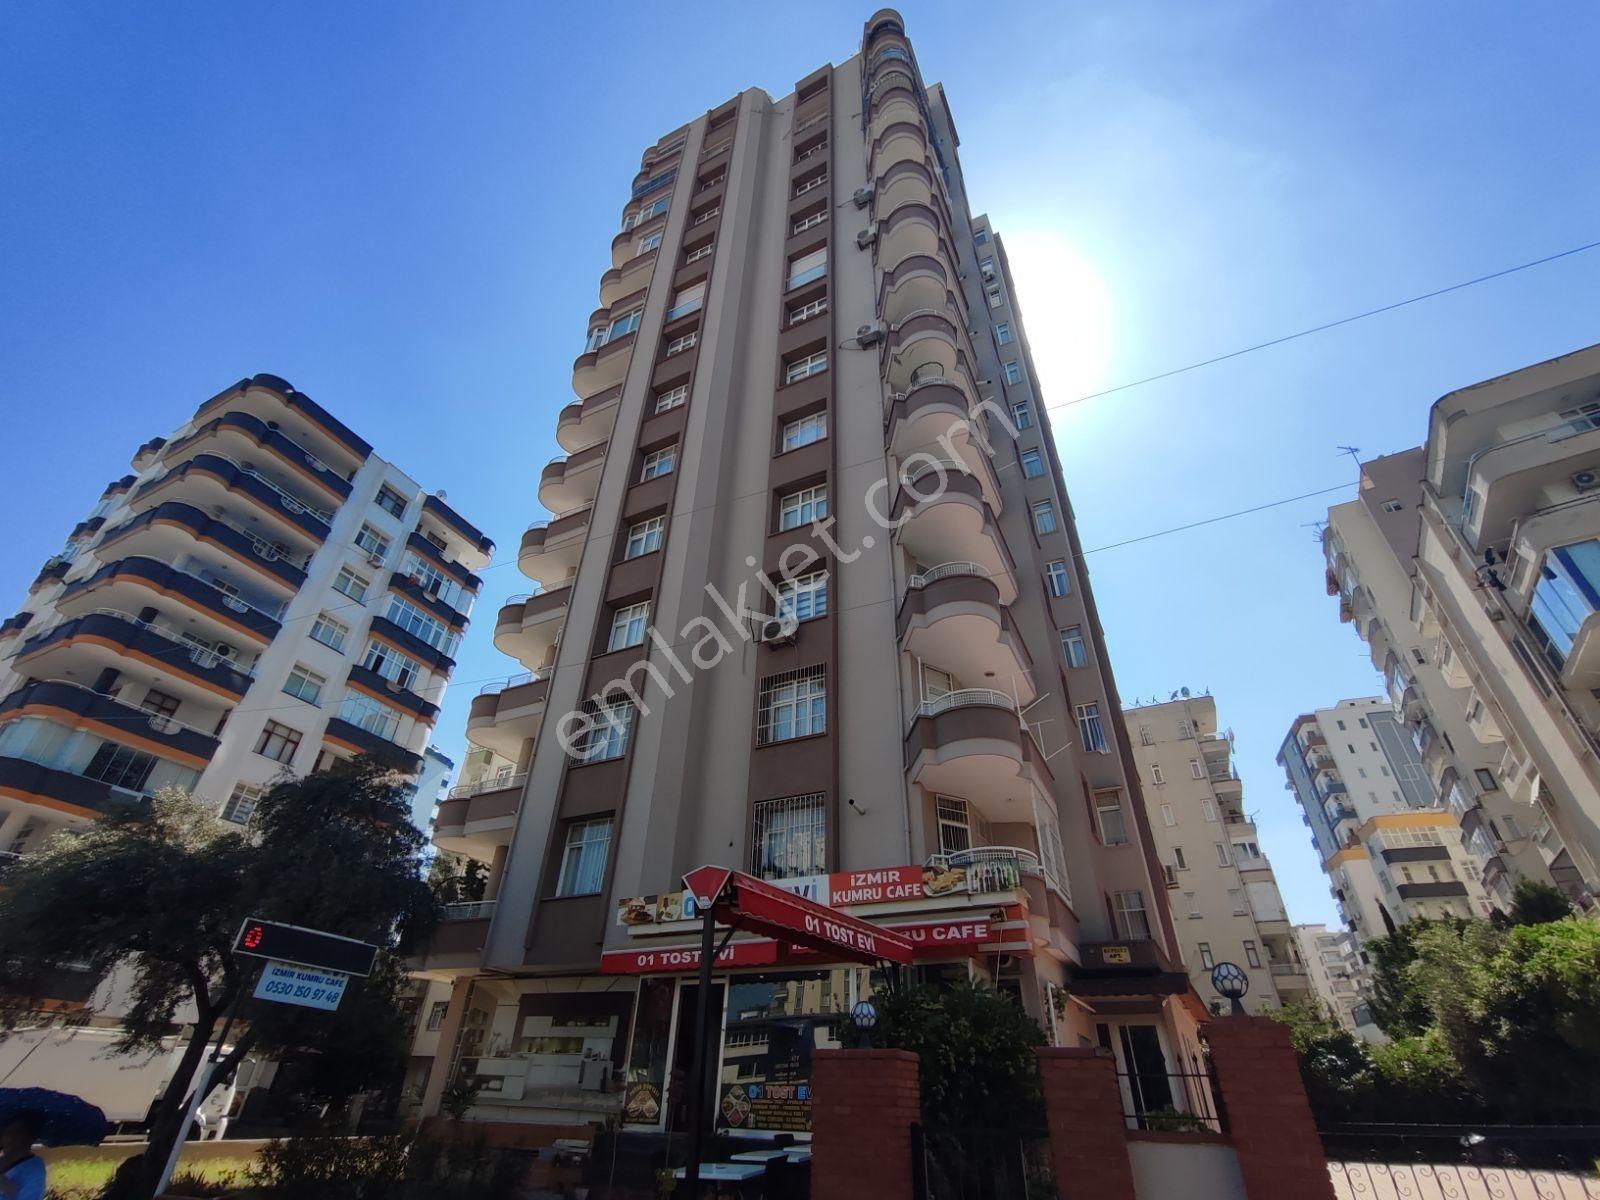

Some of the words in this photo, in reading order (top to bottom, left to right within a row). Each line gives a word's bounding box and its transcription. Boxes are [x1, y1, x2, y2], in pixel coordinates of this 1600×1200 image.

[833, 887, 882, 903] KUMRU
[886, 883, 921, 898] CAFE
[805, 915, 820, 934] 01
[824, 921, 854, 945] TOST
[932, 924, 988, 940] CAFE
[637, 954, 654, 966] 01
[660, 950, 702, 965] TOST
[296, 972, 324, 983] KUMRU
[266, 980, 293, 995] 0530
[293, 985, 311, 998] 150
[312, 988, 326, 1001] 97
[326, 991, 340, 1003] 48
[748, 1084, 764, 1099] 01
[765, 1085, 796, 1099] TOST
